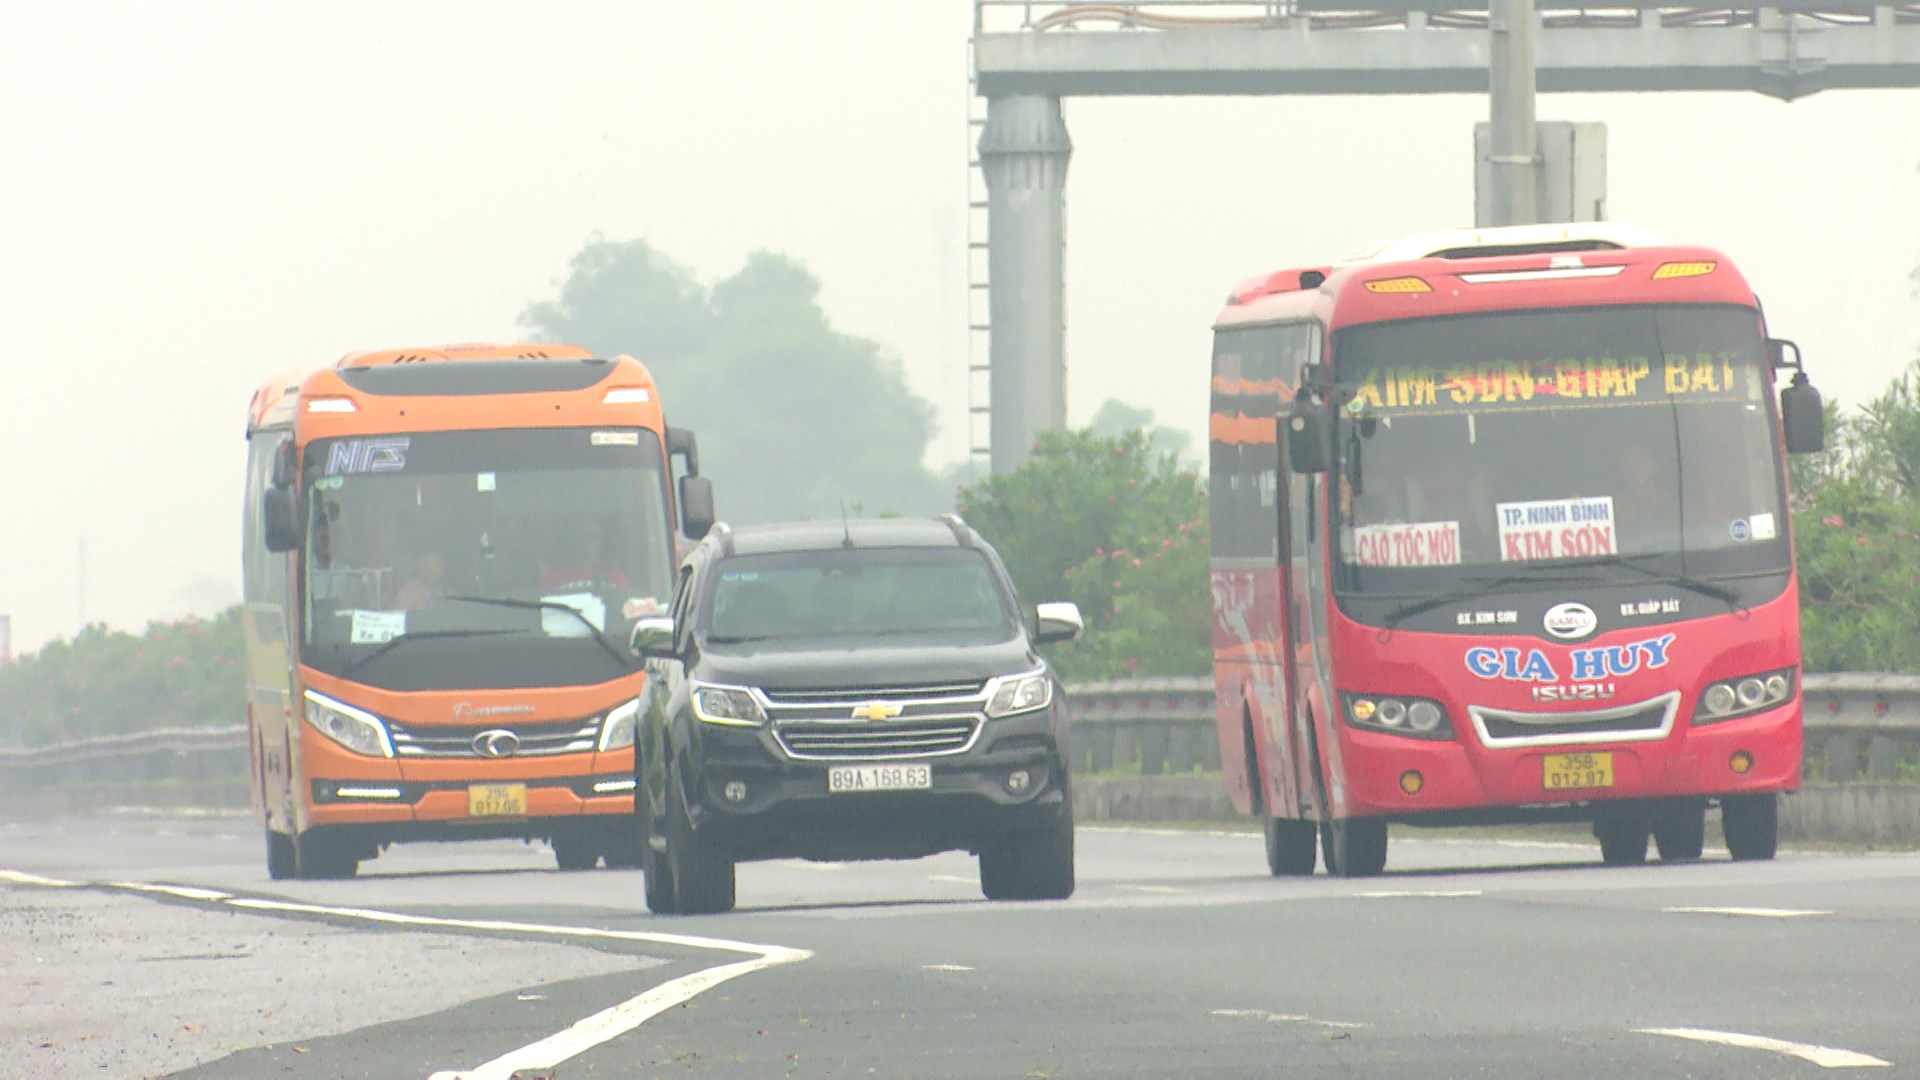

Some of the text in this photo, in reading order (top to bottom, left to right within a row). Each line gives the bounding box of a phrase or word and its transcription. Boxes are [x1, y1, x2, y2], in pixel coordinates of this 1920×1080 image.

[1527, 505, 1566, 524] NINH
[1359, 533, 1390, 567] CAO
[1504, 523, 1611, 561] KIM SƠN
[1464, 633, 1676, 682] GIA HUY
[1532, 682, 1615, 702] ISUZU
